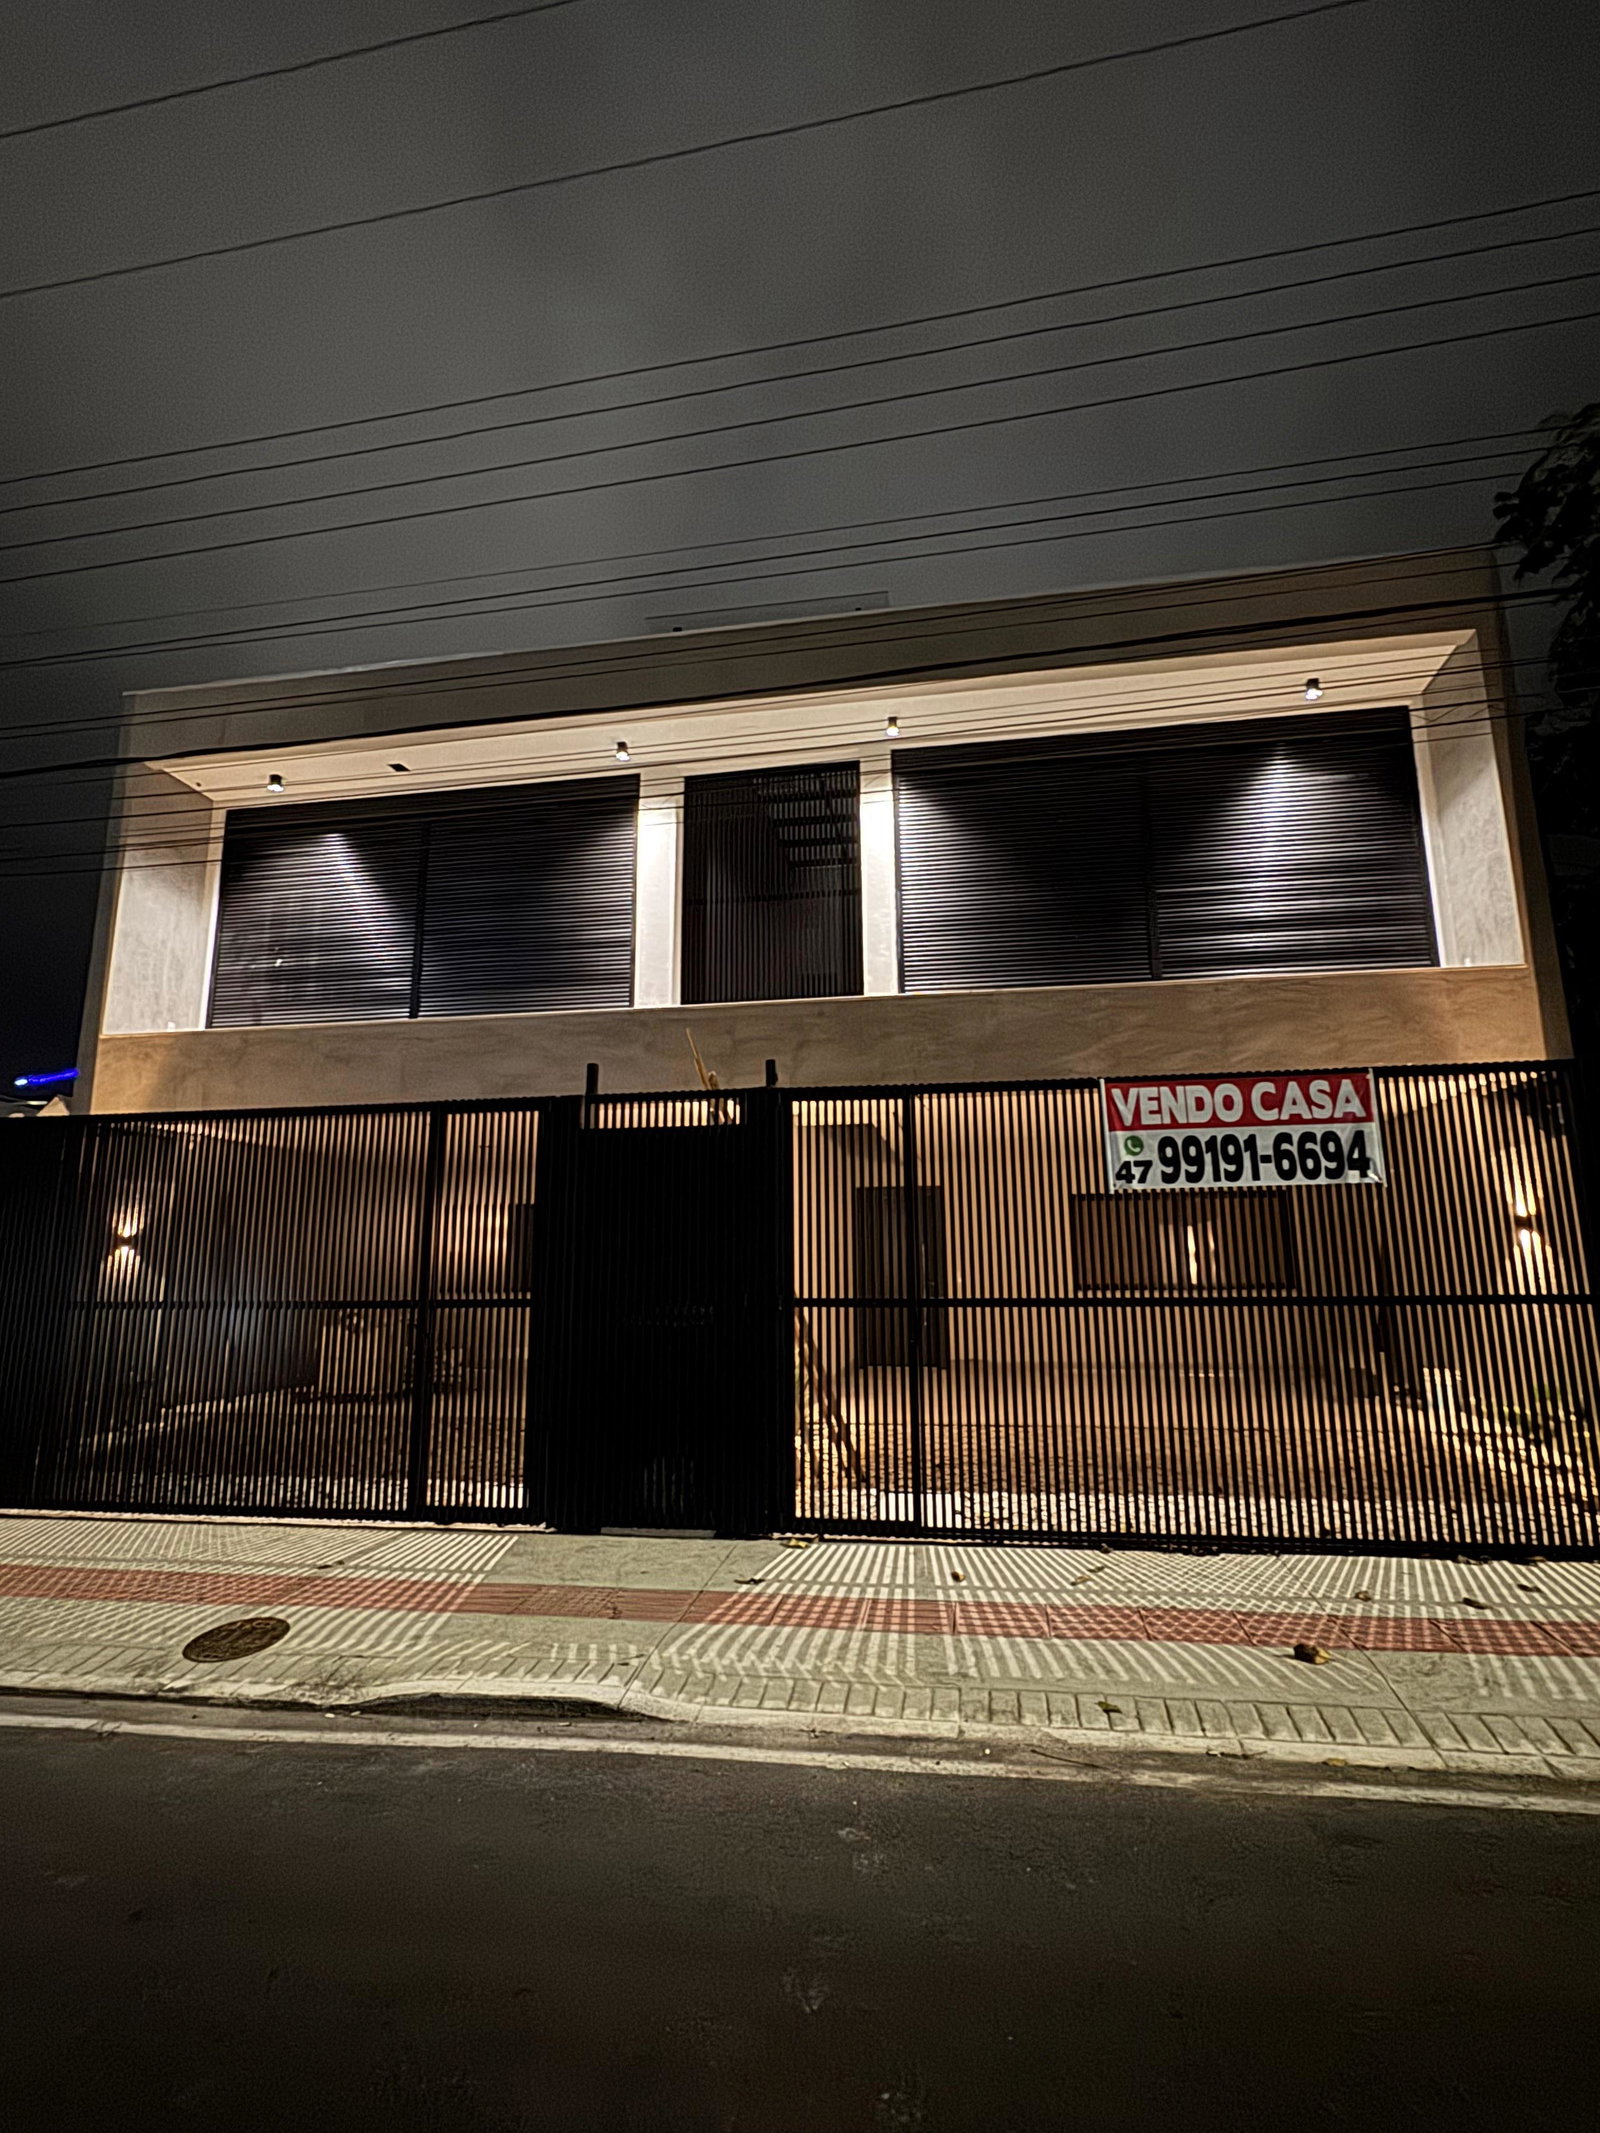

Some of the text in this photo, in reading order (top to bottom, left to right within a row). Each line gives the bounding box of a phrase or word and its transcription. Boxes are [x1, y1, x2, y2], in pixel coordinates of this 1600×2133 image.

[1110, 1079, 1367, 1127] VENDO CASA
[1115, 1130, 1371, 1184] 47 99191-6694
